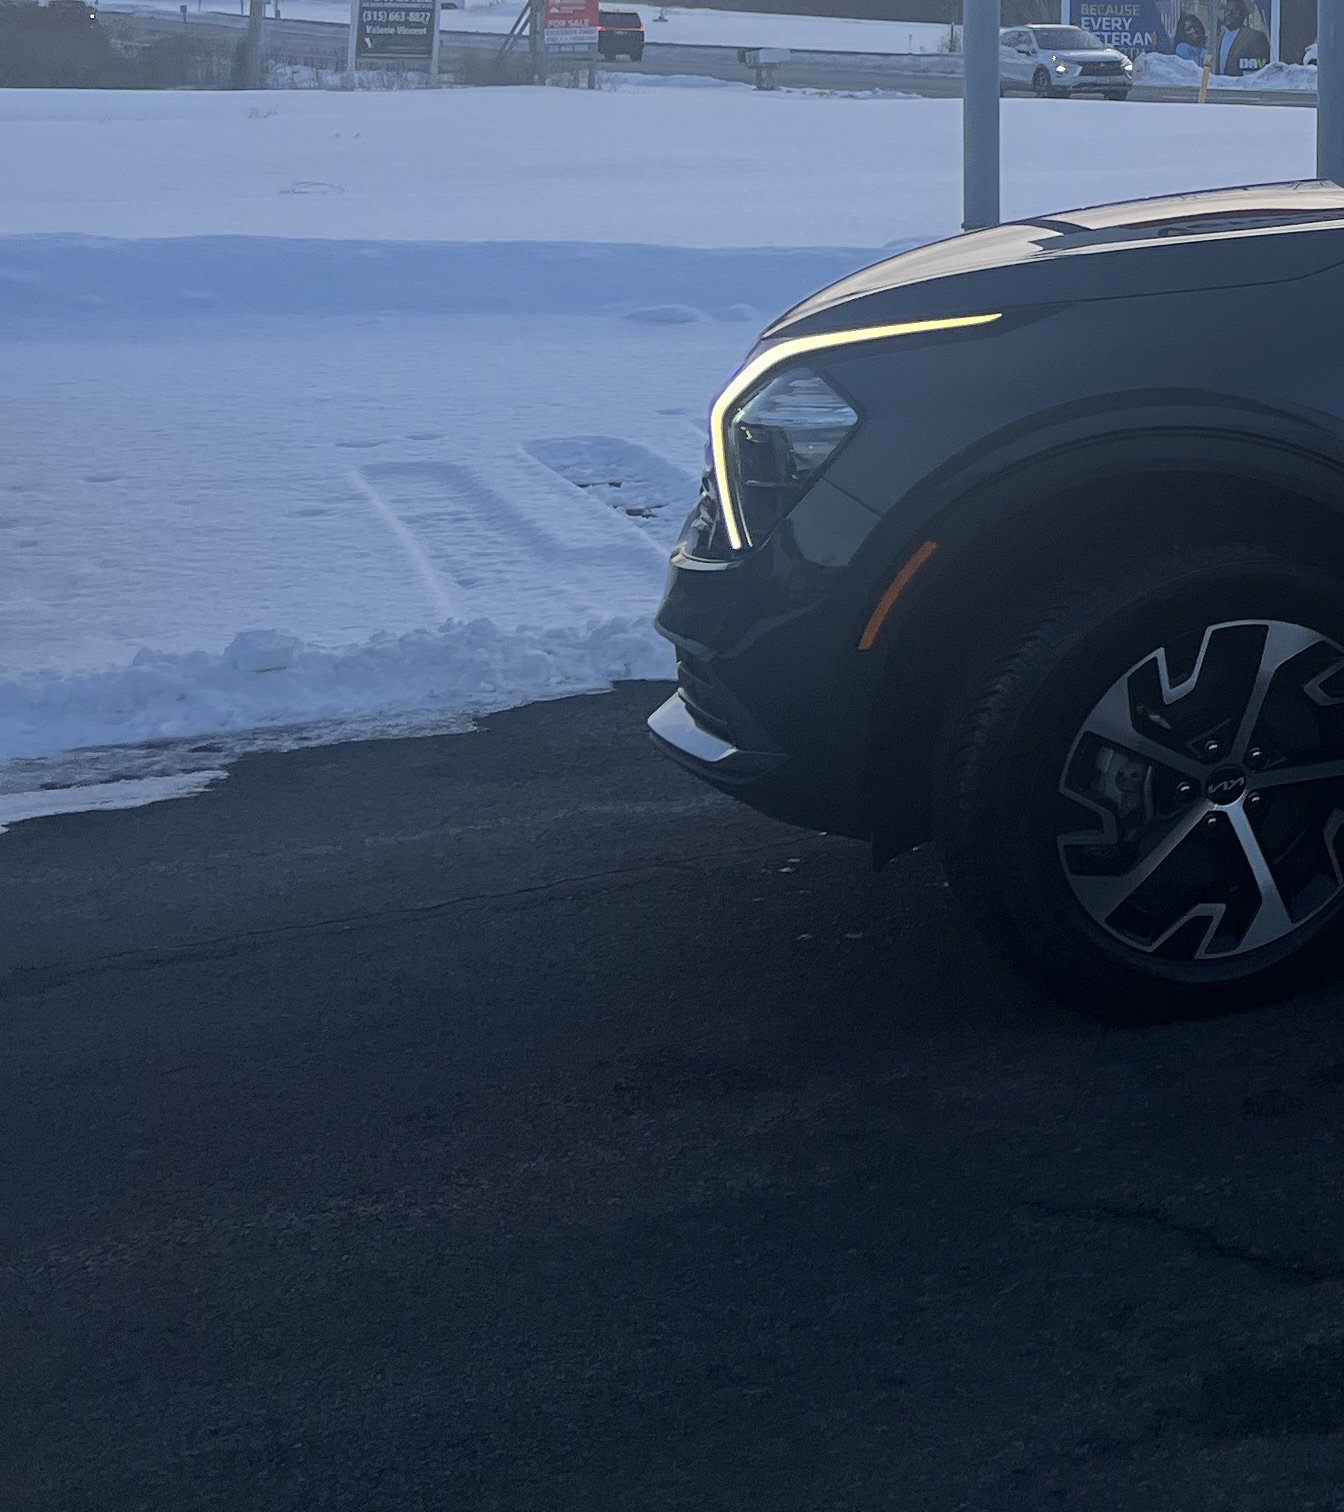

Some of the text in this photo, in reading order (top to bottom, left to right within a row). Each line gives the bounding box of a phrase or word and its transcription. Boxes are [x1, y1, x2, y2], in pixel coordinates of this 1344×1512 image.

[1080, 3, 1141, 16] BECAUSE
[362, 10, 388, 23] (315)
[547, 18, 590, 28] FOR SALE
[1080, 16, 1132, 31] EVERY
[1093, 31, 1154, 47] TERAN
